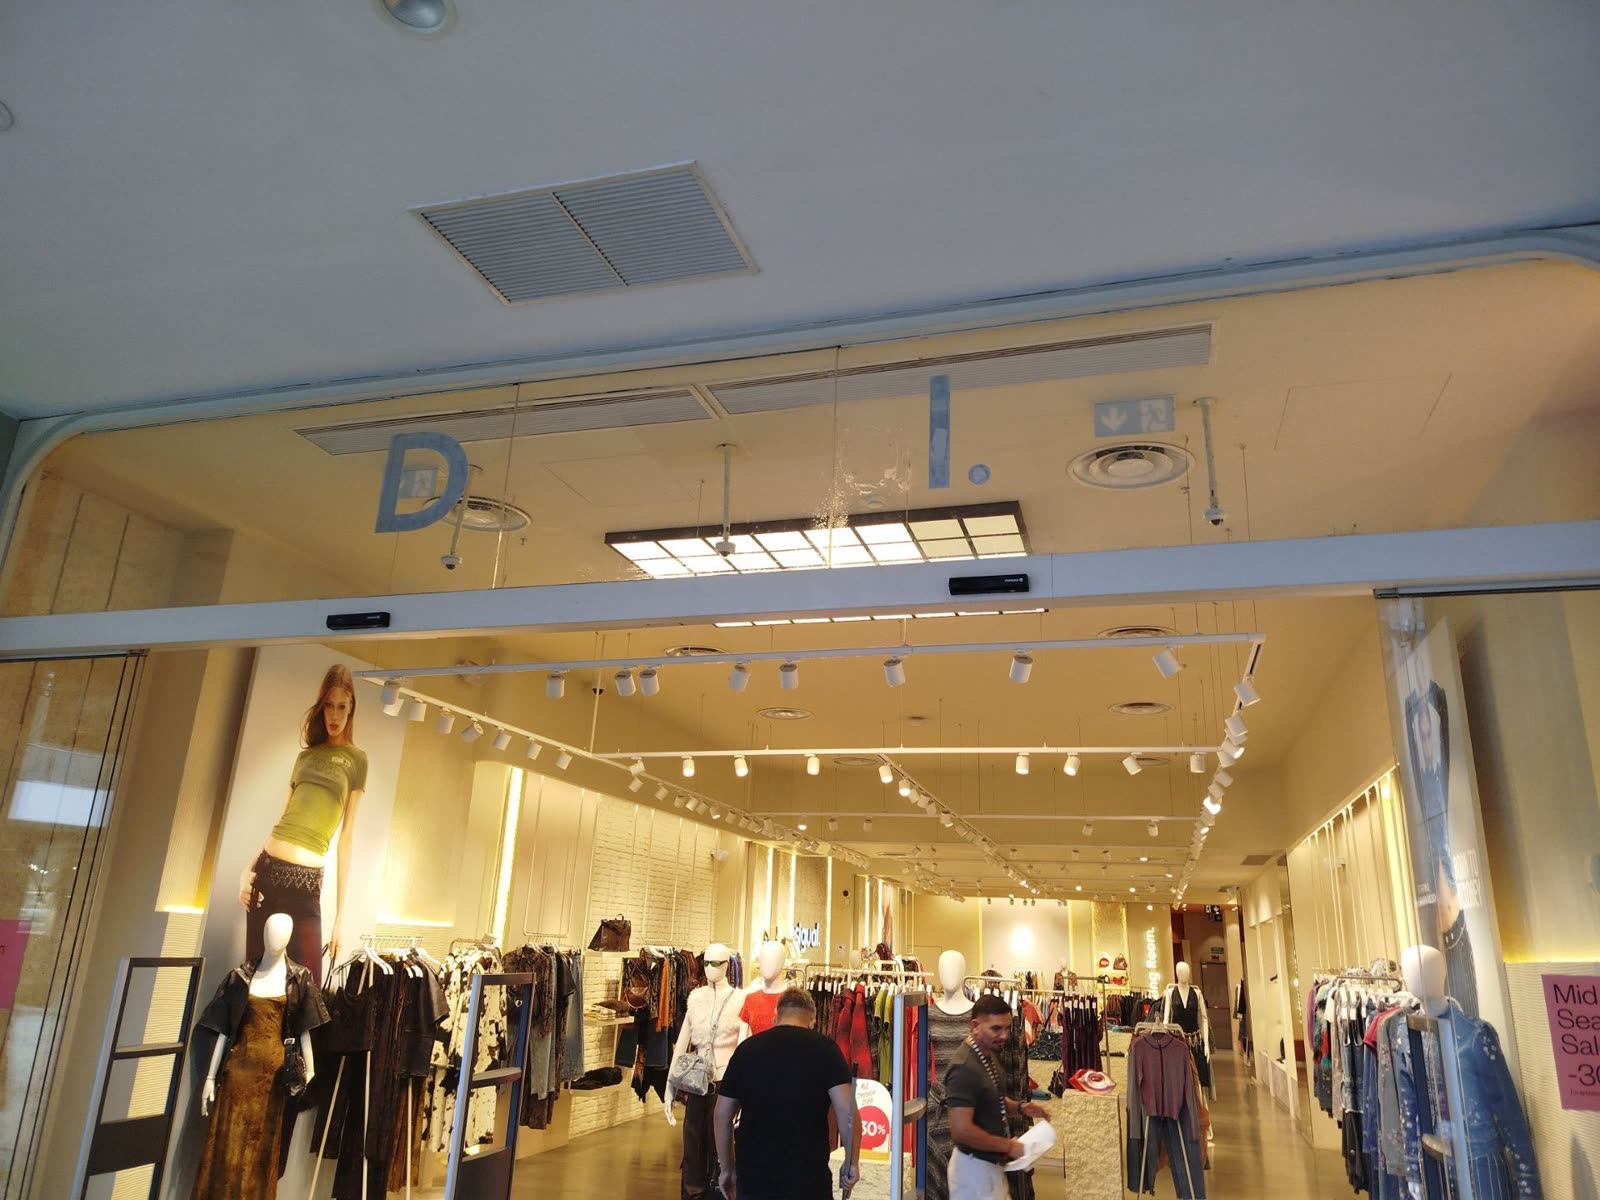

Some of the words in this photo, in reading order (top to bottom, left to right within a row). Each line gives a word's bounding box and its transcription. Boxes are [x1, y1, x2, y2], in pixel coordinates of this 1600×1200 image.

[374, 431, 468, 533] D
[1553, 984, 1598, 1005] Mid
[1561, 1033, 1600, 1056] Sal
[1568, 1063, 1600, 1087] -3
